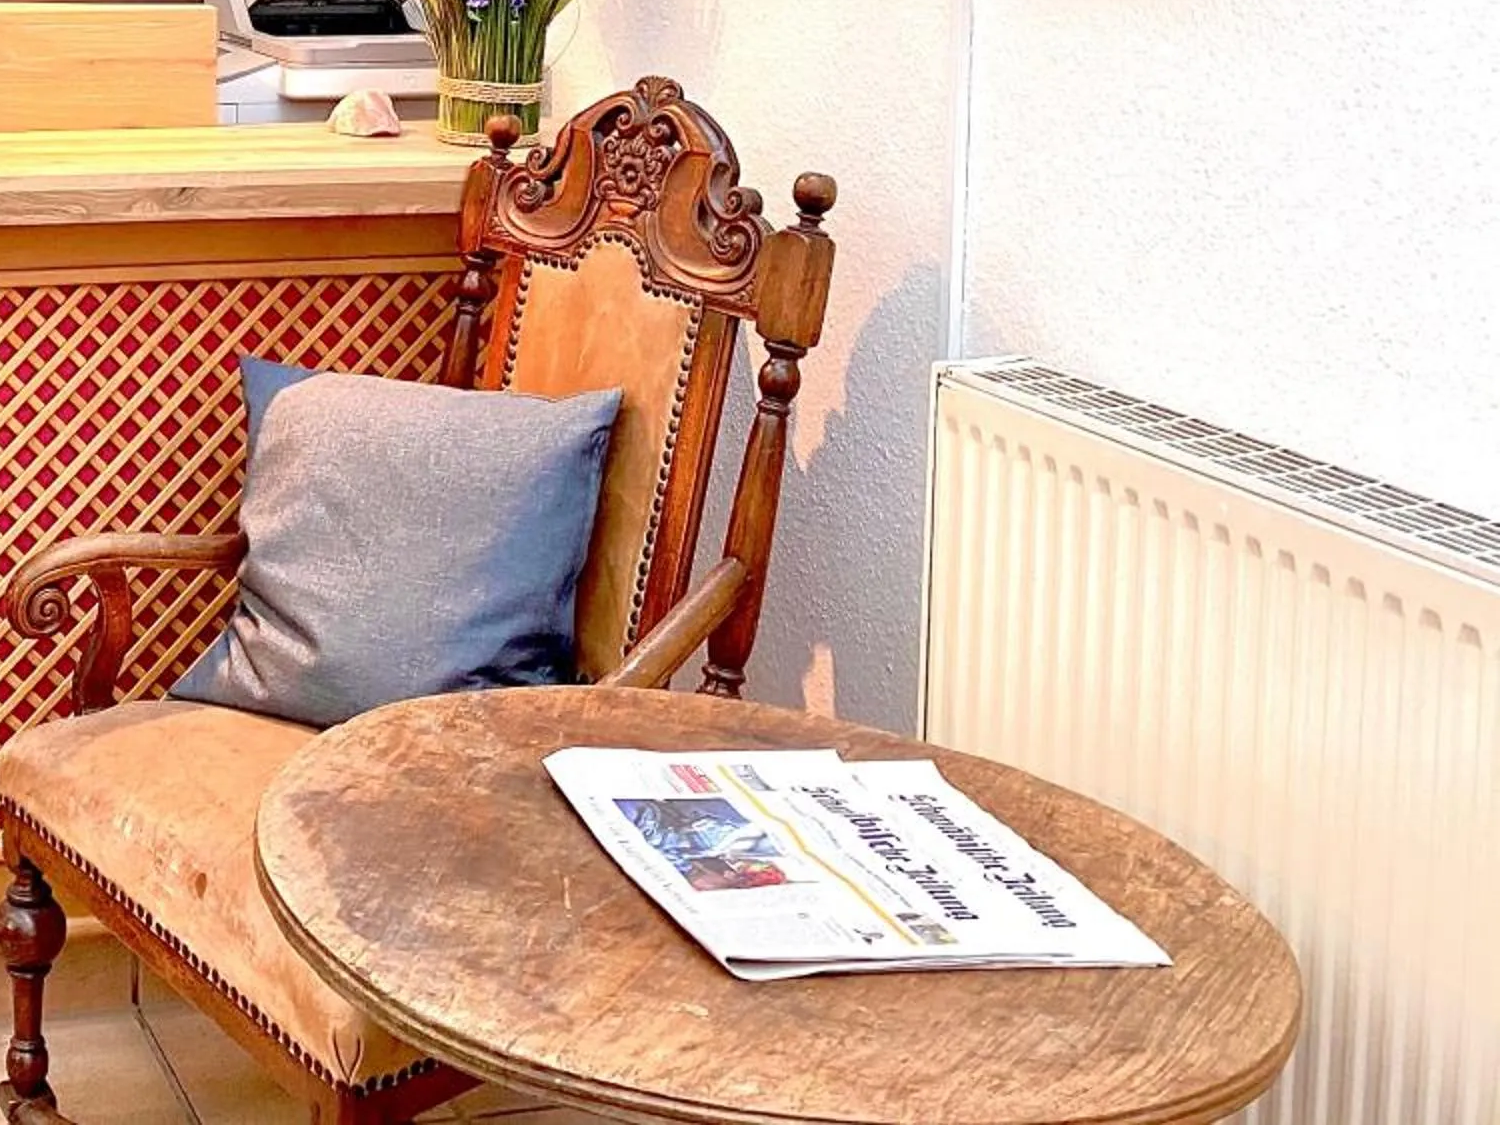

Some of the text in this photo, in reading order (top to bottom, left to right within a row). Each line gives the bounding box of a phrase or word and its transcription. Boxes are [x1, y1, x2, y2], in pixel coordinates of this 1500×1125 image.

[791, 786, 911, 863] Schbische
[886, 865, 979, 920] Zeitung
[984, 873, 1077, 928] Zeitung
